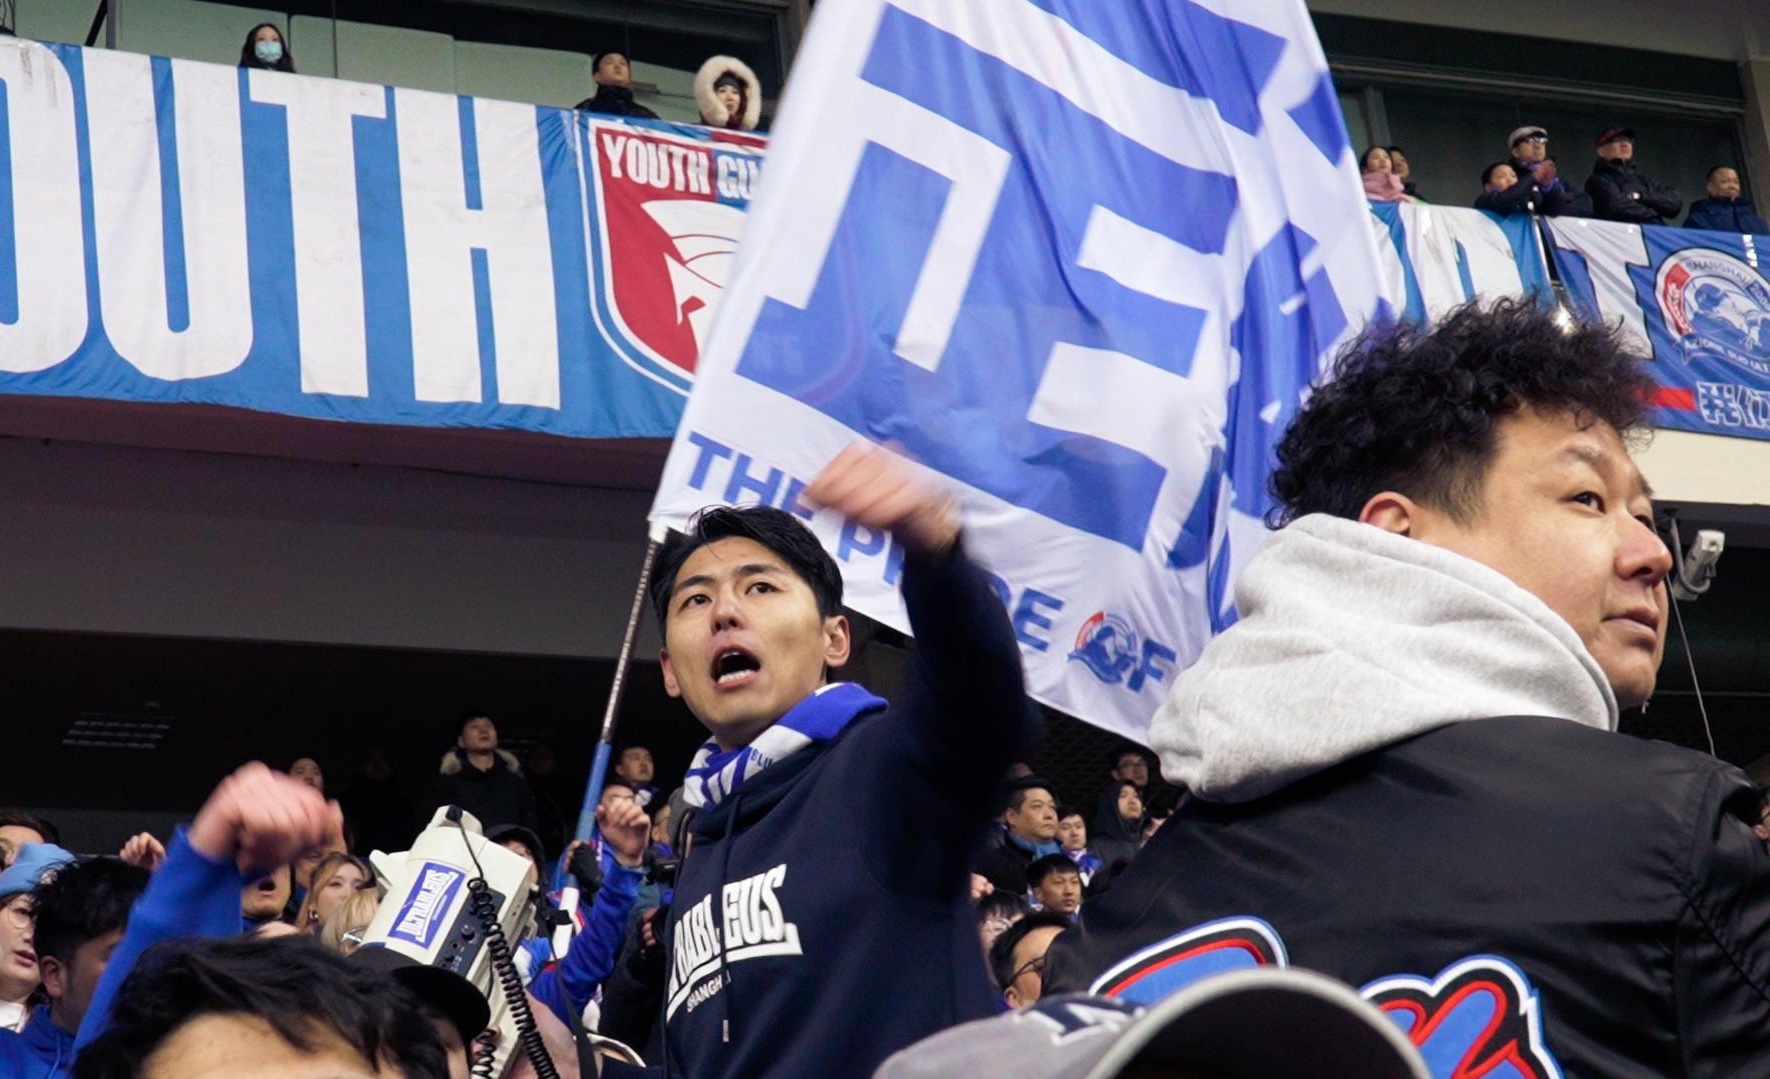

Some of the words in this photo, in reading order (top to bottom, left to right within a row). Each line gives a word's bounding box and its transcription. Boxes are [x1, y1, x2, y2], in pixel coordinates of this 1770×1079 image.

[602, 133, 711, 195] YOUTH
[688, 430, 814, 521] THE
[686, 967, 732, 1013] SHANGHI
